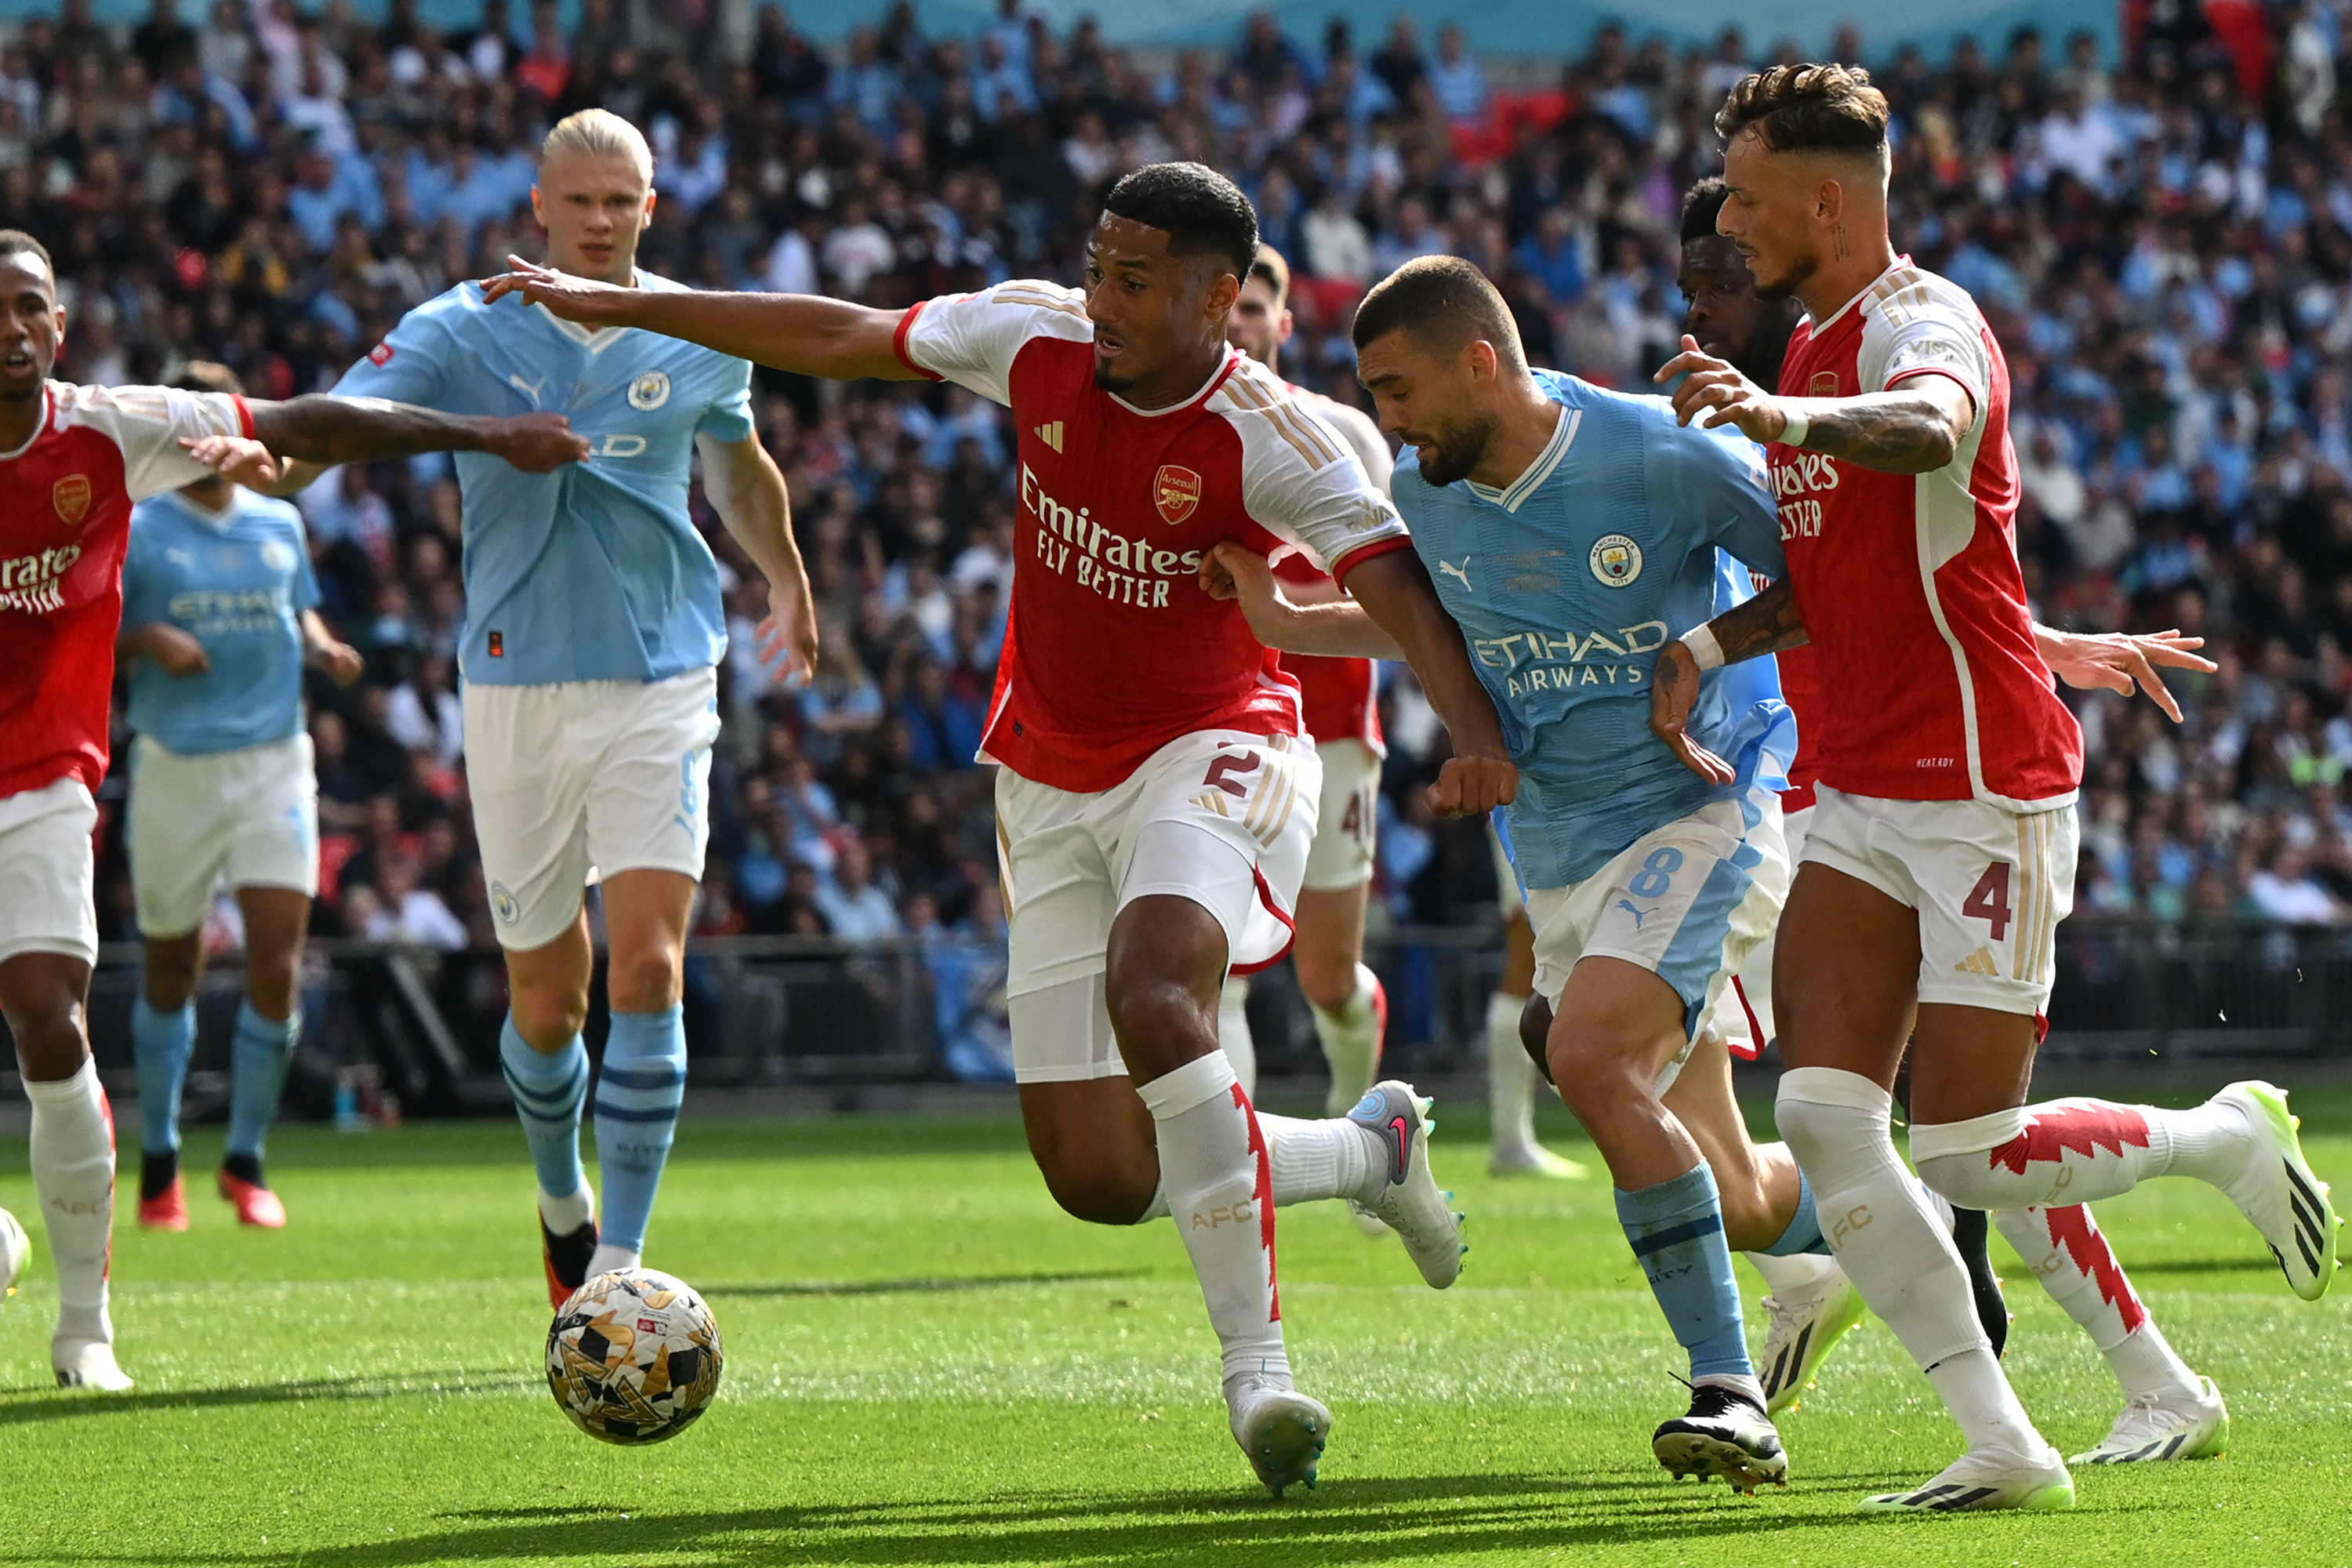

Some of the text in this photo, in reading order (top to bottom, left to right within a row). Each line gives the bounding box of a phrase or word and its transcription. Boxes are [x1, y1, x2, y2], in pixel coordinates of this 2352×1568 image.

[1162, 474, 1194, 490] Arsenal
[1022, 460, 1201, 575] Emirates
[1037, 528, 1170, 608] FLY BETTER
[1592, 536, 1635, 557] MANCHESTER
[1474, 620, 1668, 667] ETIHAD
[1508, 664, 1642, 698] AIRWAYS
[1203, 741, 1261, 798] 2
[1628, 847, 1683, 898] 8
[1962, 861, 2012, 942] 4
[1192, 1200, 1254, 1231] AFC
